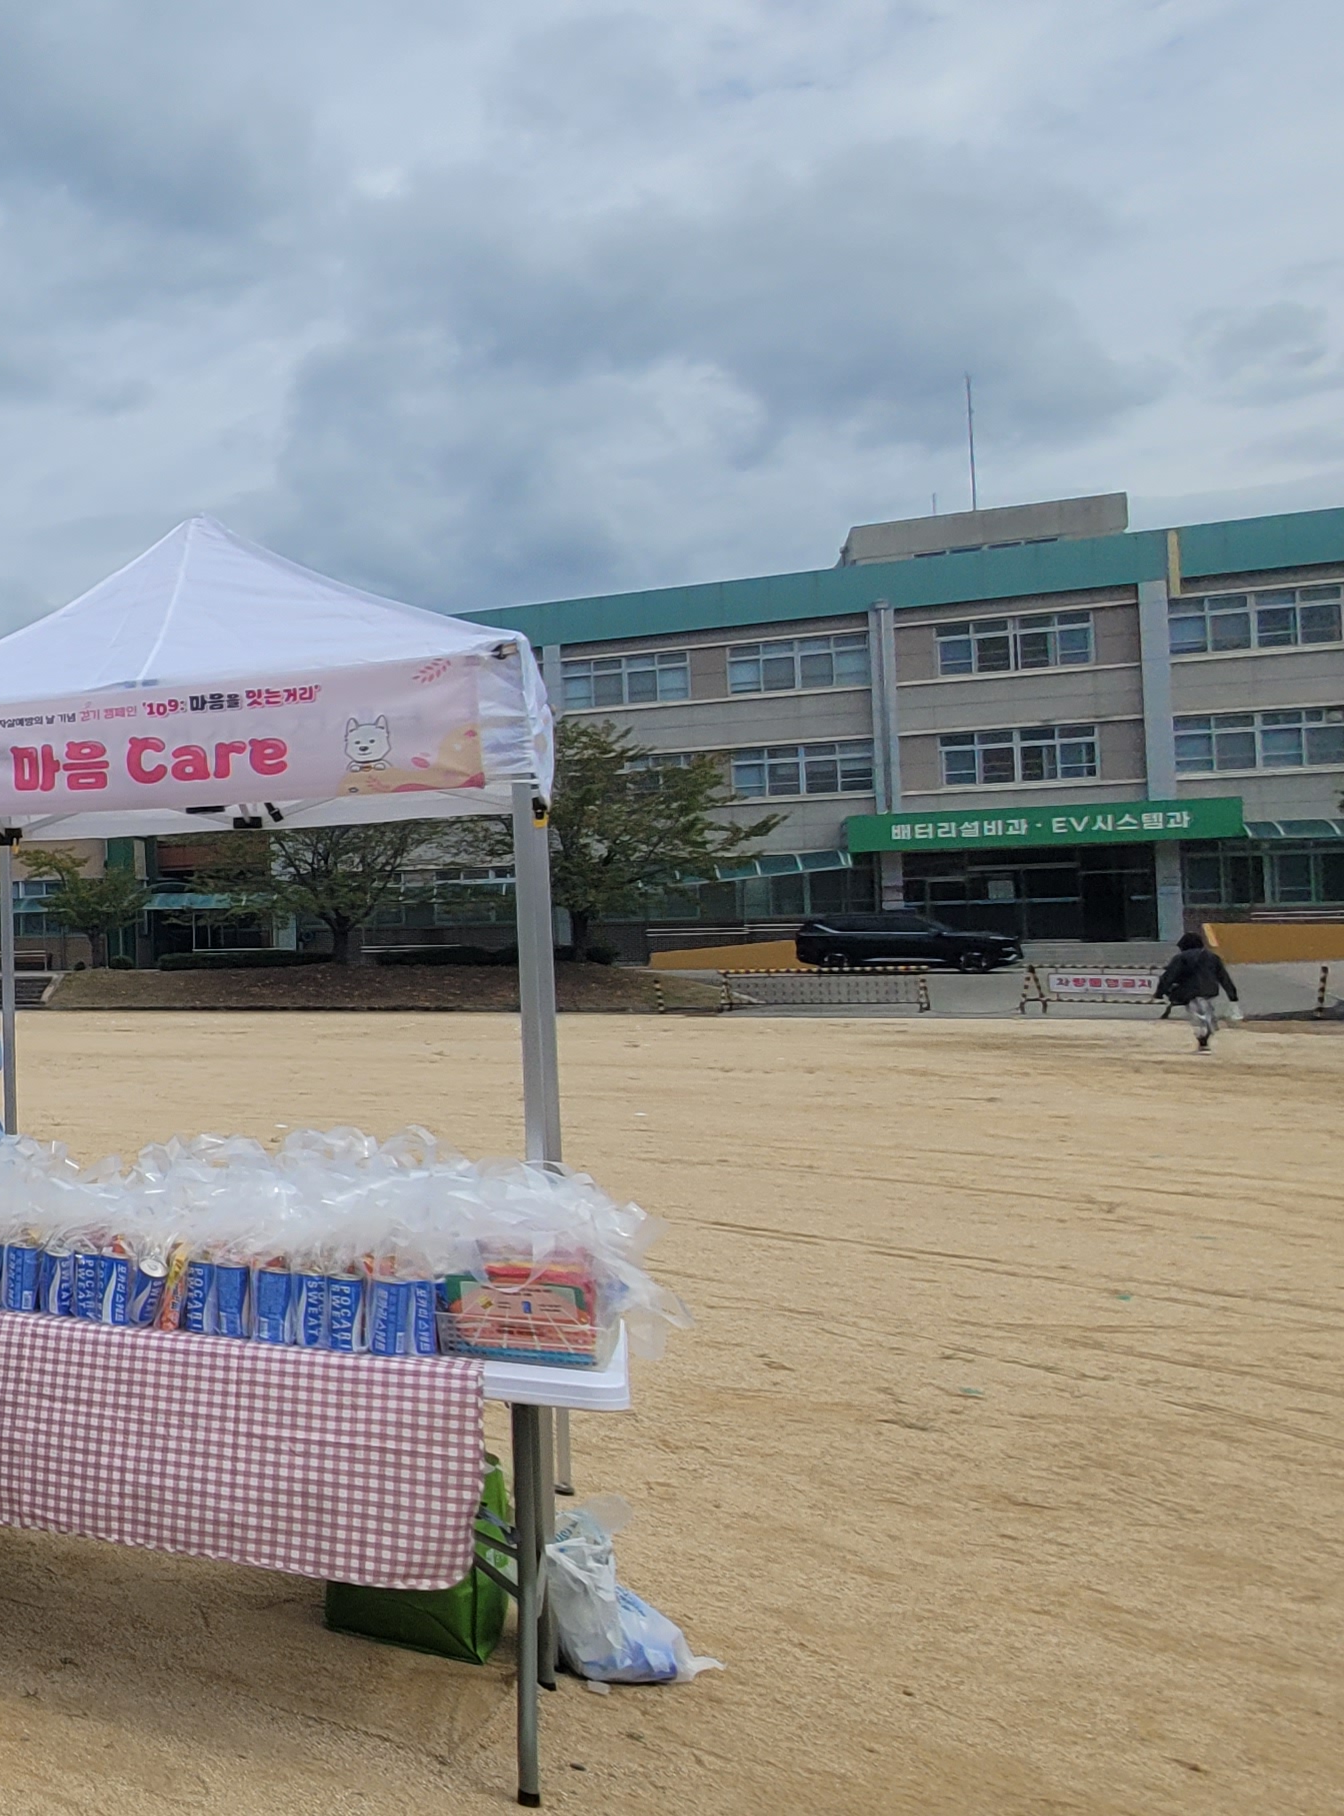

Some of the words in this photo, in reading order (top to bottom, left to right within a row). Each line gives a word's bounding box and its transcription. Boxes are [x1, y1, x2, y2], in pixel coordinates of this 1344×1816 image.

[45, 714, 55, 725] 날
[57, 712, 76, 723] 기념
[79, 708, 100, 722] 걷기
[104, 705, 137, 720] 캠페인
[189, 692, 240, 711] 마음을
[10, 740, 110, 792] 마음
[126, 736, 288, 785] Care
[890, 817, 1028, 841] 배터리설비과
[1051, 810, 1192, 834] EV시스템과
[307, 1280, 318, 1338] SWEAT
[339, 1285, 352, 1349] POCARI
